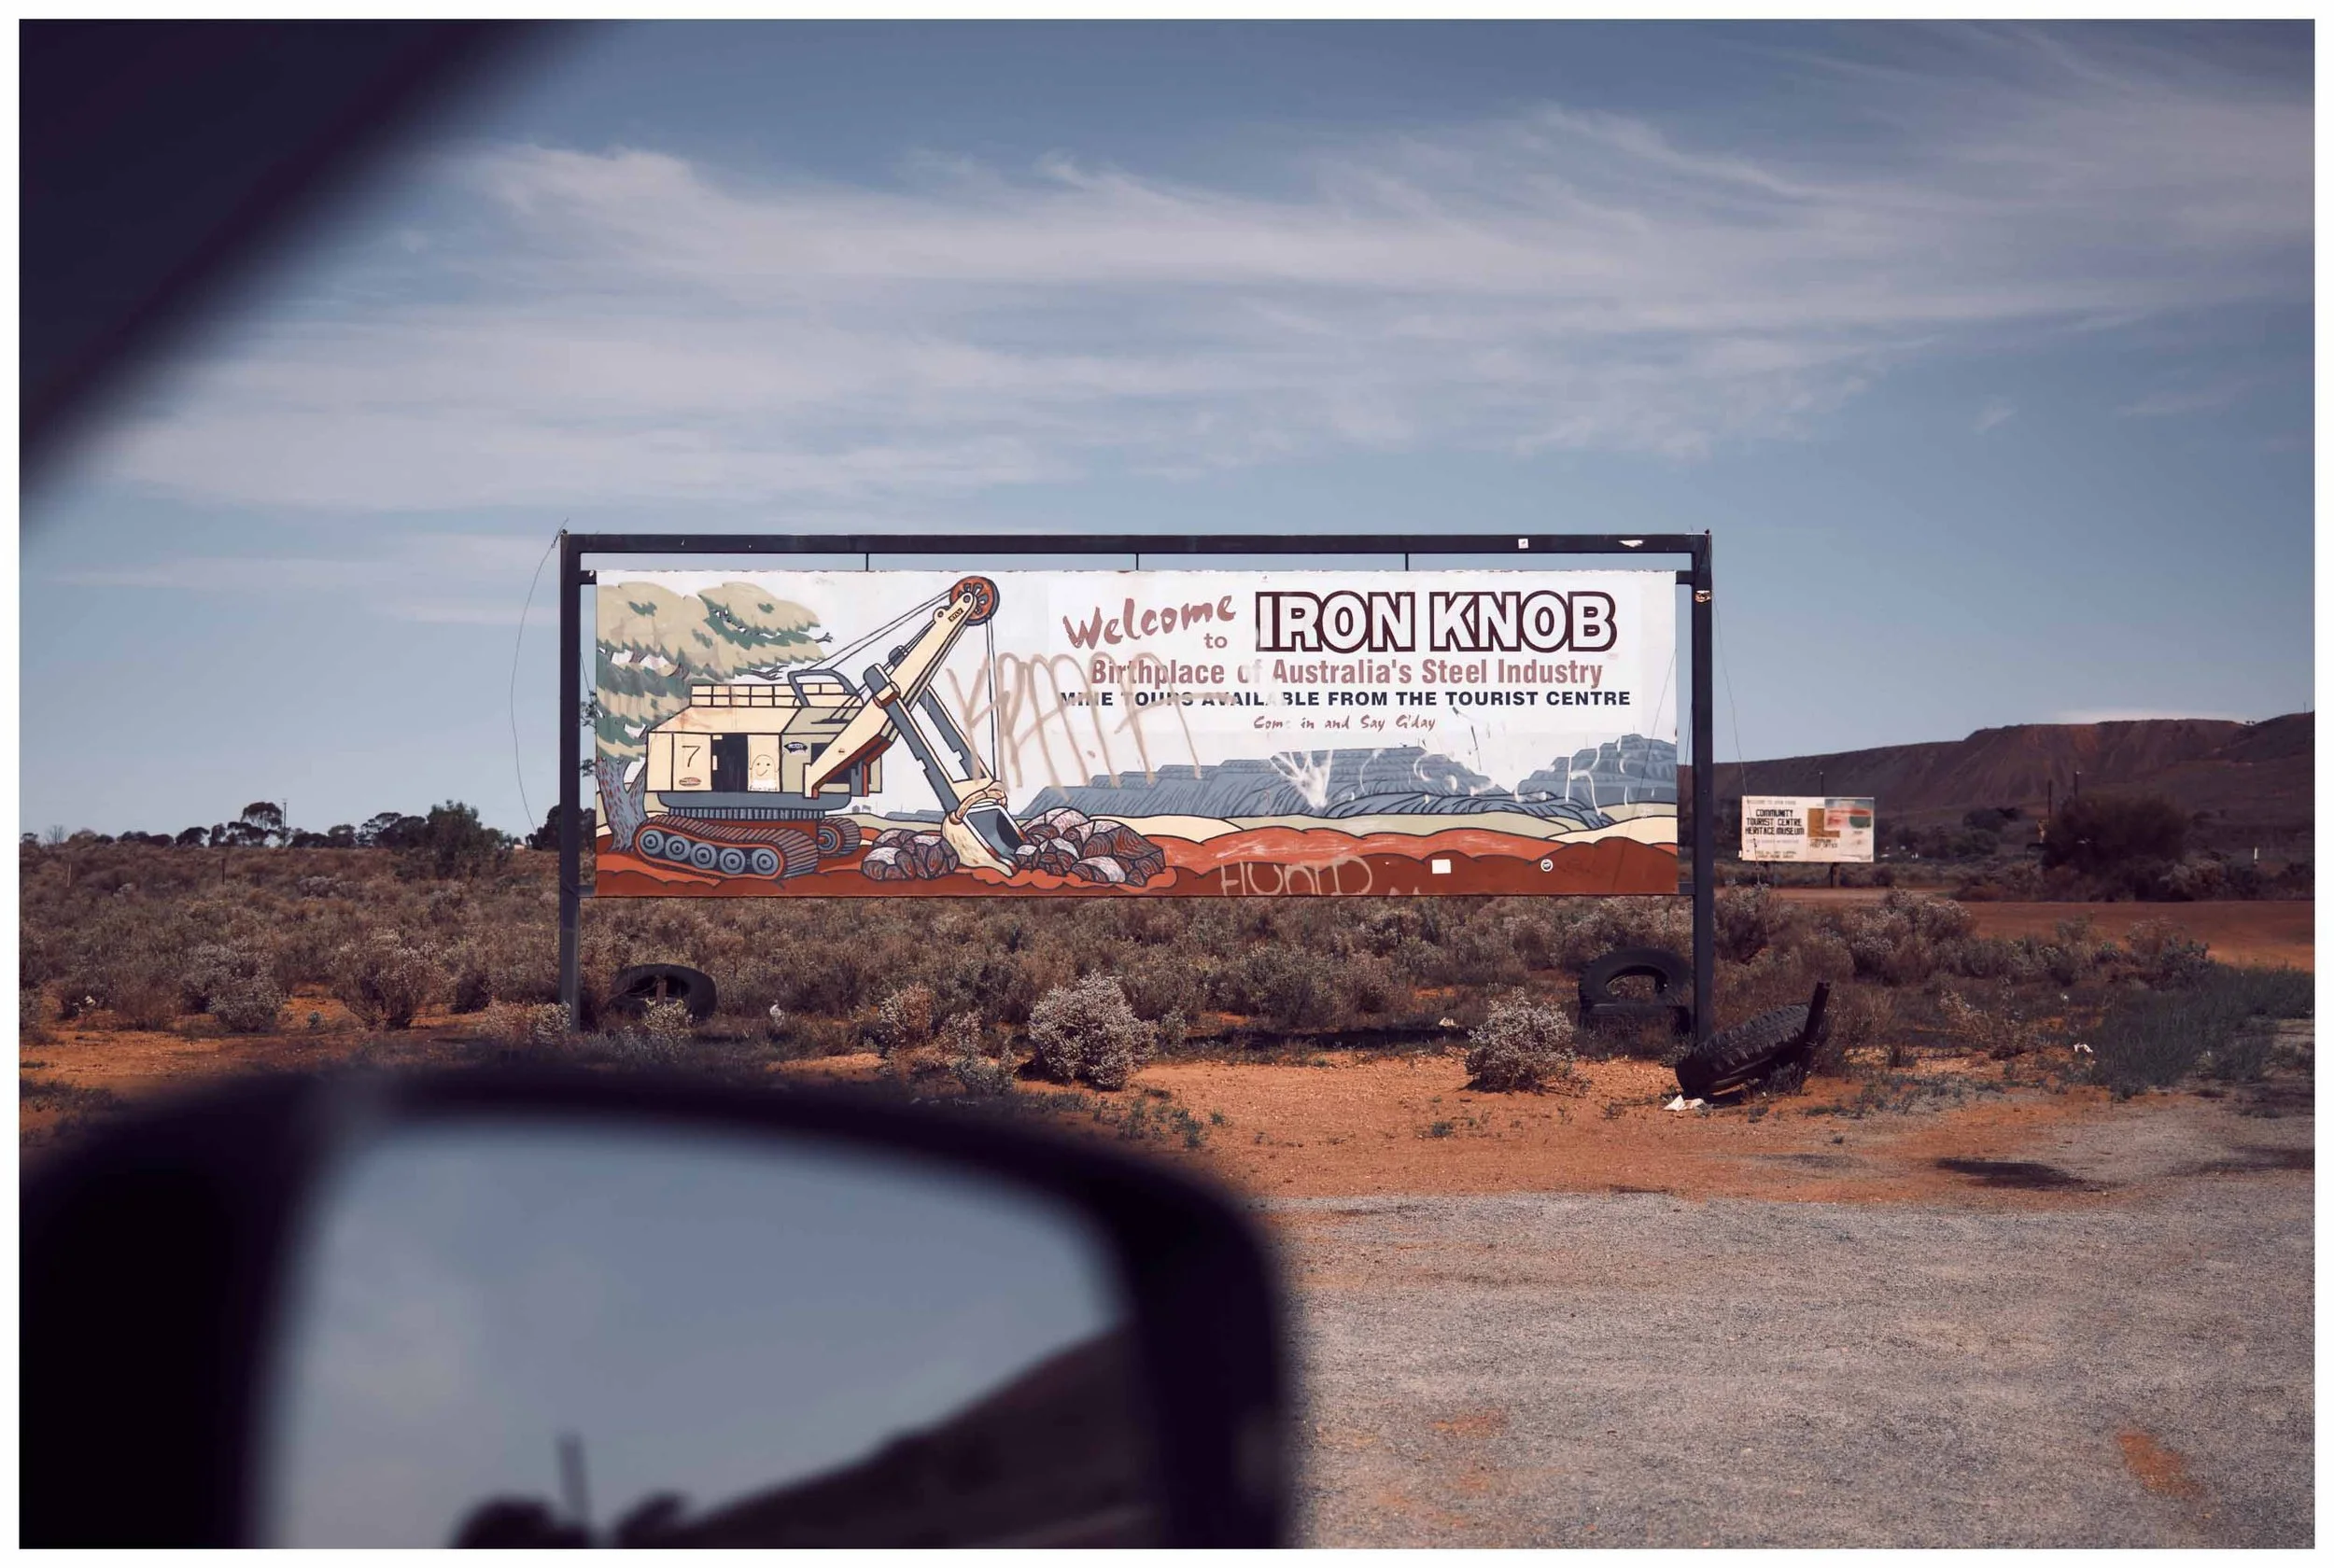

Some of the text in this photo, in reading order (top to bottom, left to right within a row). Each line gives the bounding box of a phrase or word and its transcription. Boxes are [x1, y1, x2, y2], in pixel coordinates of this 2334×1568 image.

[1062, 595, 1236, 650] Welcome
[1256, 590, 1617, 652] IRON KNOB
[1203, 633, 1228, 649] to
[1091, 659, 1225, 690] Birthplace
[1272, 659, 1412, 684] Australia's
[1422, 659, 1487, 684] Steel
[1498, 659, 1603, 690] Industry
[1328, 692, 1387, 707] FROM
[1396, 692, 1437, 706] THE
[1445, 692, 1538, 706] TOURIST
[1547, 692, 1630, 706] CENTRE
[1301, 717, 1315, 730] in
[1325, 716, 1350, 730] and
[1360, 715, 1385, 732] Say
[1395, 715, 1436, 731] G'day
[682, 745, 701, 768] 7
[1755, 808, 1793, 818] COMMUNITY
[1746, 818, 1802, 827] TOURIST CENTRE
[1776, 827, 1805, 835] MUSEUM
